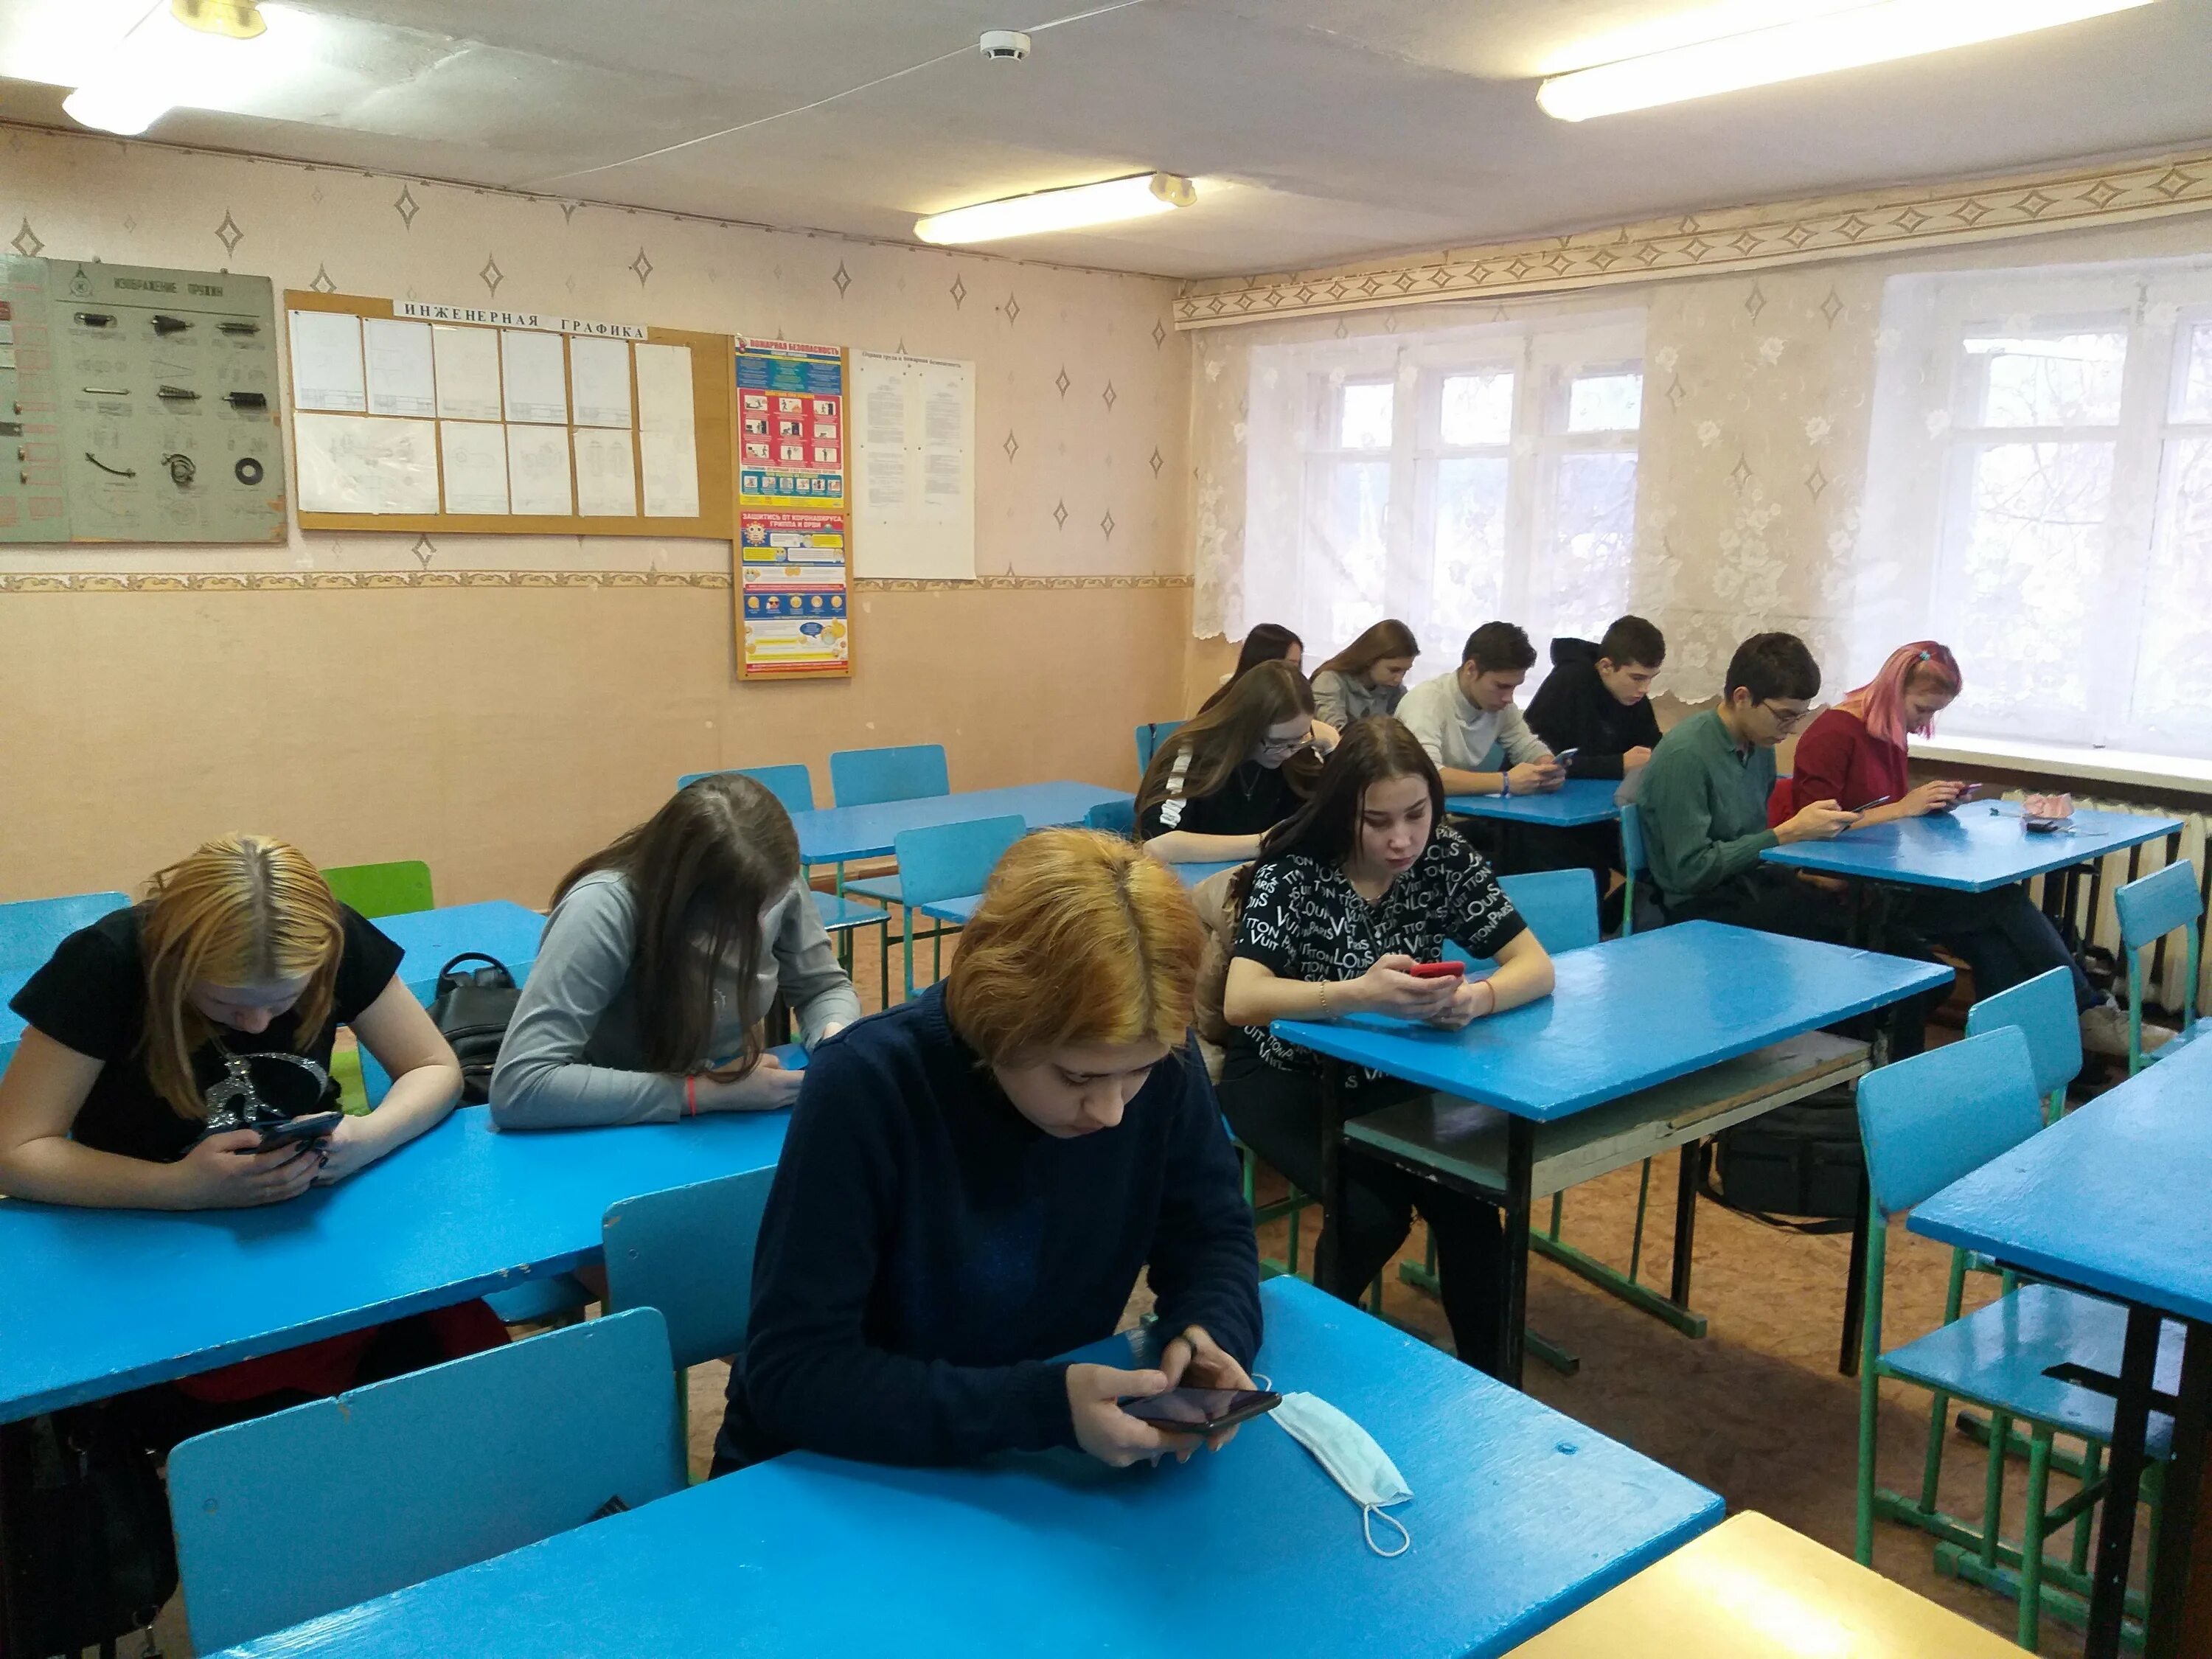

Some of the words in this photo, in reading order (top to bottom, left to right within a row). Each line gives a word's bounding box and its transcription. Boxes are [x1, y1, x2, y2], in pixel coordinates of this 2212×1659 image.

[404, 303, 539, 327] ИНЖЕНЕРНАЯ
[560, 319, 644, 338] ГРАФИКА
[750, 339, 787, 350] ПОЖАРНАЯ
[788, 344, 840, 355] БЕЗОПАСНОСТЬ
[1459, 883, 1501, 922] LOUIS
[1251, 930, 1279, 950] VUIT
[1333, 947, 1374, 968] LOUIS
